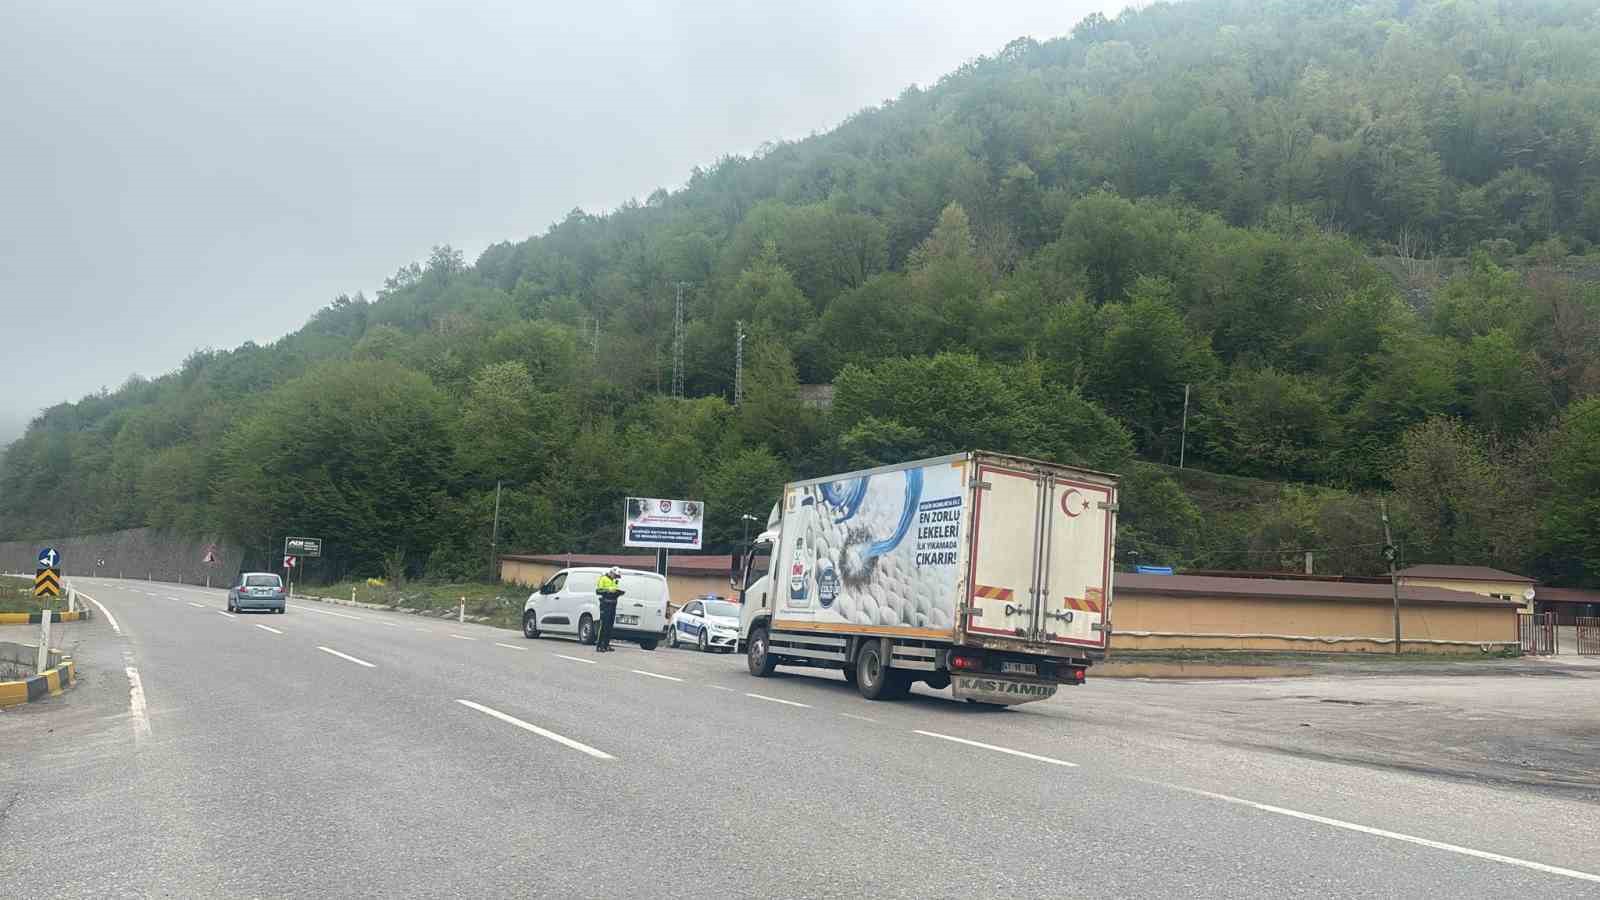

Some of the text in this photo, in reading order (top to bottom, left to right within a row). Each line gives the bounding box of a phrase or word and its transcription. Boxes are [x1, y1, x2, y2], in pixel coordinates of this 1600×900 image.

[919, 510, 960, 524] EN ZORLU
[918, 523, 960, 540] LEKELERİ
[926, 541, 957, 551] YIKAMADA
[916, 551, 957, 568] ÇIKARIR!
